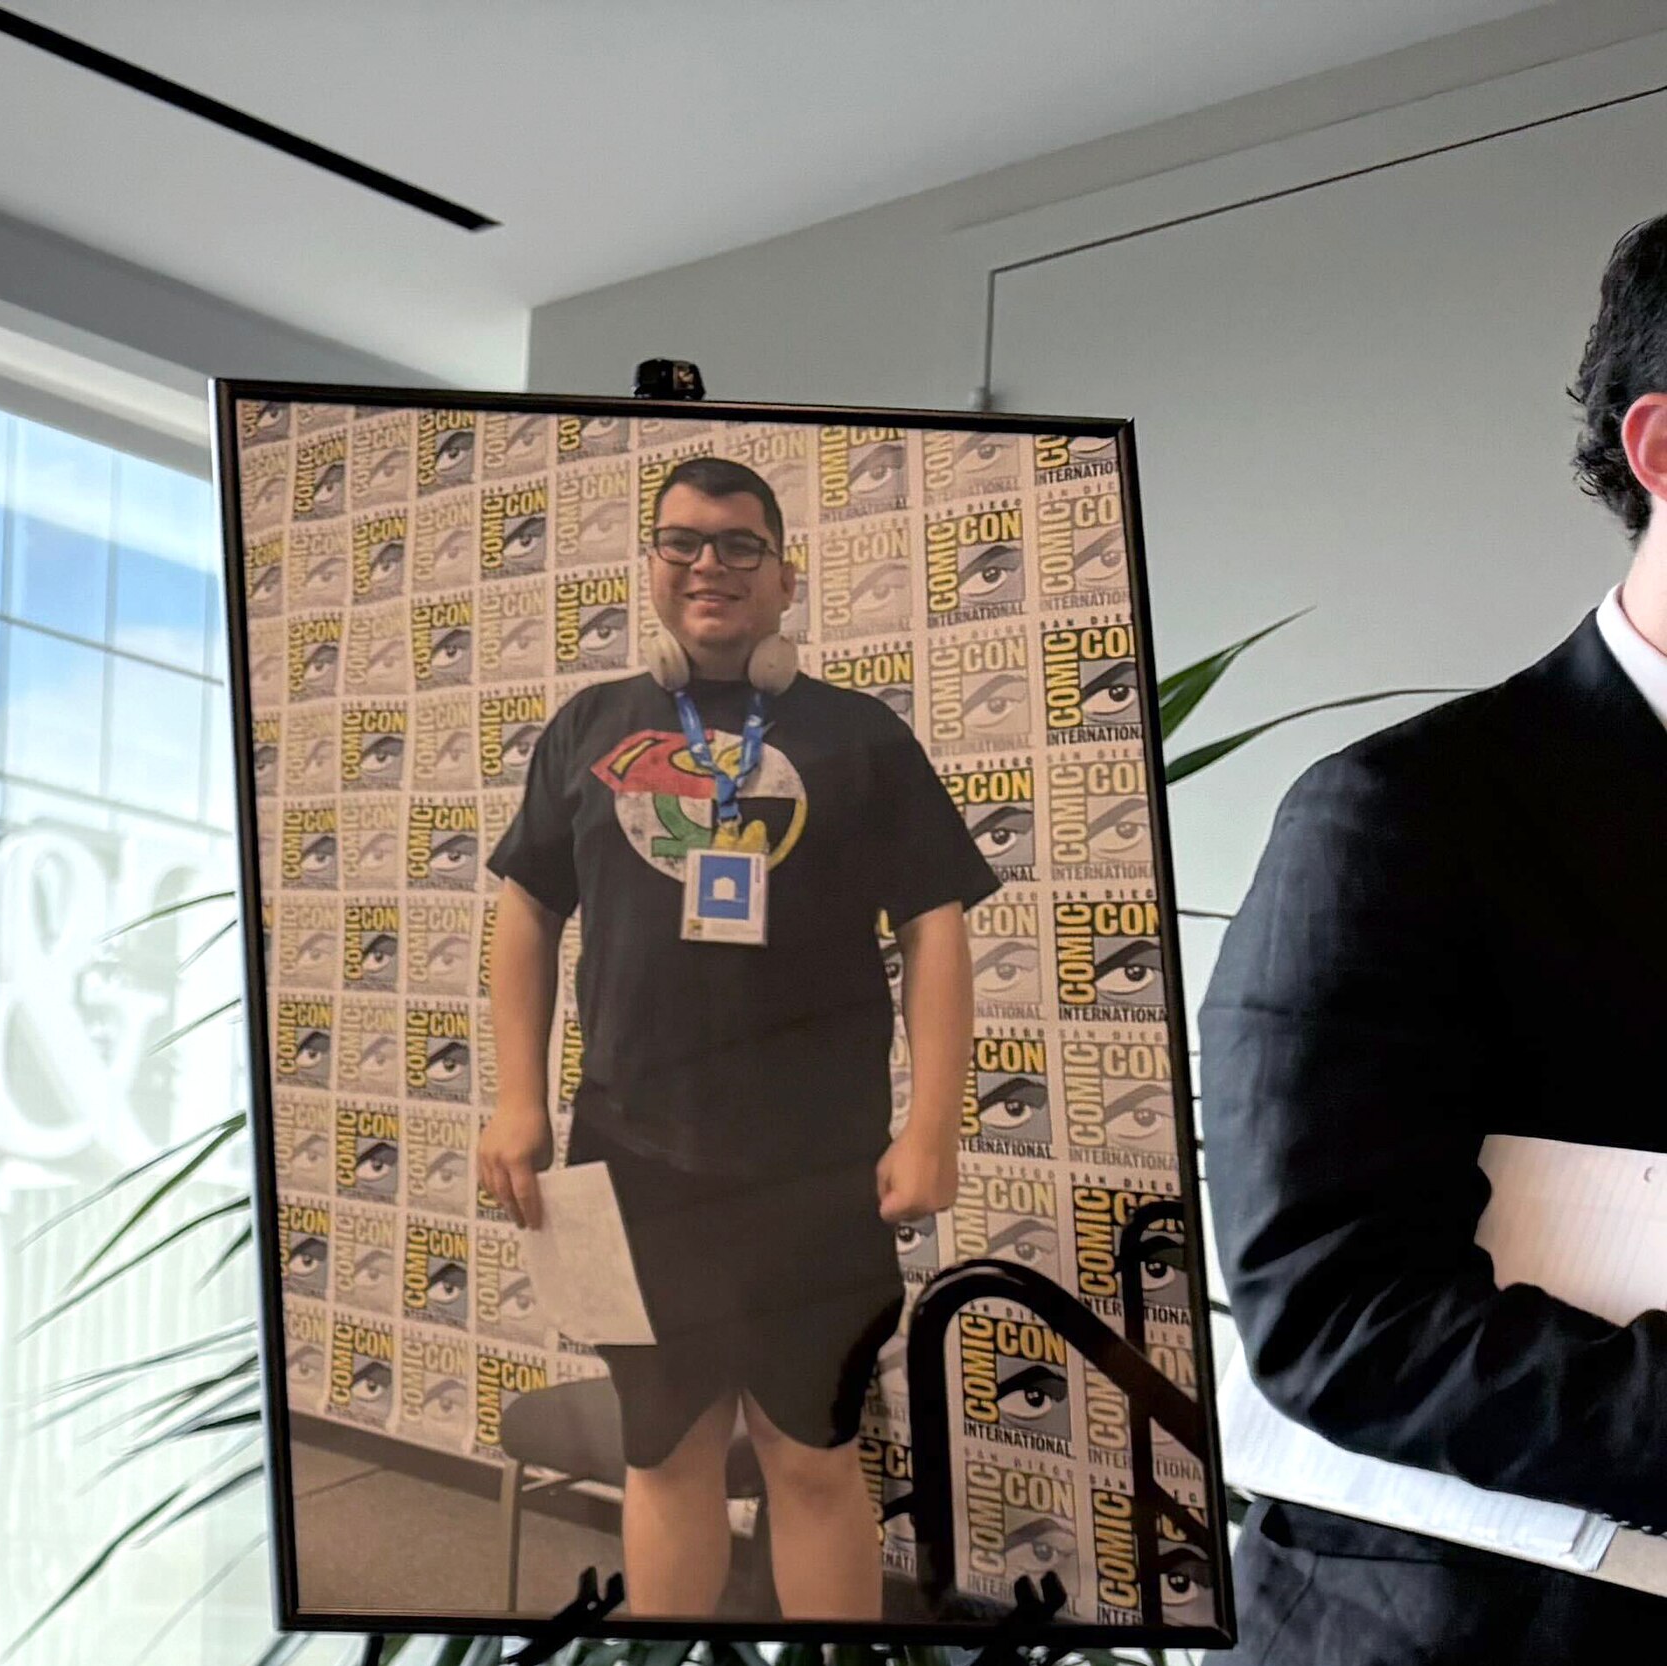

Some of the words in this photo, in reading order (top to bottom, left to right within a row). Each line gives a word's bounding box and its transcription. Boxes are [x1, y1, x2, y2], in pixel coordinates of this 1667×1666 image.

[436, 410, 475, 429] CON
[822, 425, 849, 508] COMIC
[370, 518, 406, 542] CON
[482, 497, 504, 569] COMIC
[505, 489, 546, 516] CON
[928, 522, 958, 611] COMIC
[959, 510, 1022, 545] CON
[1039, 501, 1074, 594] COMIC
[823, 539, 851, 626] COMIC
[852, 529, 909, 562] CON
[304, 621, 342, 644] CON
[413, 607, 432, 679] COMIC
[432, 603, 472, 627] CON
[557, 585, 578, 662] COMIC
[581, 578, 627, 604] CON
[928, 605, 1026, 628] INTERNATIONAL
[856, 654, 913, 688] CON
[932, 647, 962, 740] COMIC
[963, 638, 1026, 672] CON
[1044, 632, 1080, 727] COMIC
[1081, 627, 1133, 658] CO
[343, 711, 362, 781] COMIC
[363, 711, 406, 732] CON
[482, 698, 501, 776] COMIC
[503, 696, 546, 721] CON
[1047, 727, 1143, 745] INTERNATION
[967, 770, 1033, 802] CON
[1051, 765, 1088, 863] COMIC
[283, 812, 301, 879] COMIC
[303, 811, 336, 832] CON
[408, 807, 432, 878] COMIC
[434, 807, 477, 829] CON
[1052, 864, 1152, 881] INTERNATION
[344, 907, 362, 981] COMIC
[362, 907, 399, 930] CON
[971, 904, 1036, 936] CON
[1056, 904, 1095, 1005] COMIC
[1095, 902, 1158, 936] CON
[278, 1004, 297, 1075] COMIC
[297, 1004, 331, 1026] CON
[407, 1012, 428, 1087] COMIC
[430, 1012, 468, 1037] CON
[977, 1041, 1045, 1073] CON
[1064, 1043, 1105, 1146] COMIC
[1104, 1045, 1171, 1079] CON
[338, 1112, 357, 1186] COMIC
[358, 1112, 399, 1138] CON
[290, 1210, 330, 1233] CON
[987, 1177, 1056, 1217] CON
[405, 1228, 429, 1309] COMIC
[429, 1230, 468, 1259] CON
[1074, 1188, 1116, 1296] COMIC
[479, 1239, 499, 1323] COMIC
[333, 1324, 353, 1407] COMIC
[354, 1328, 394, 1360] CON
[478, 1358, 502, 1444] COMIC
[502, 1361, 546, 1392] CON
[961, 1315, 1000, 1422] COMIC
[995, 1321, 1067, 1364] CON
[965, 1422, 1072, 1456] INTERNATIONAL
[969, 1462, 1007, 1575] COMIC
[1004, 1471, 1075, 1519] CON
[1093, 1490, 1139, 1608] COMIC
